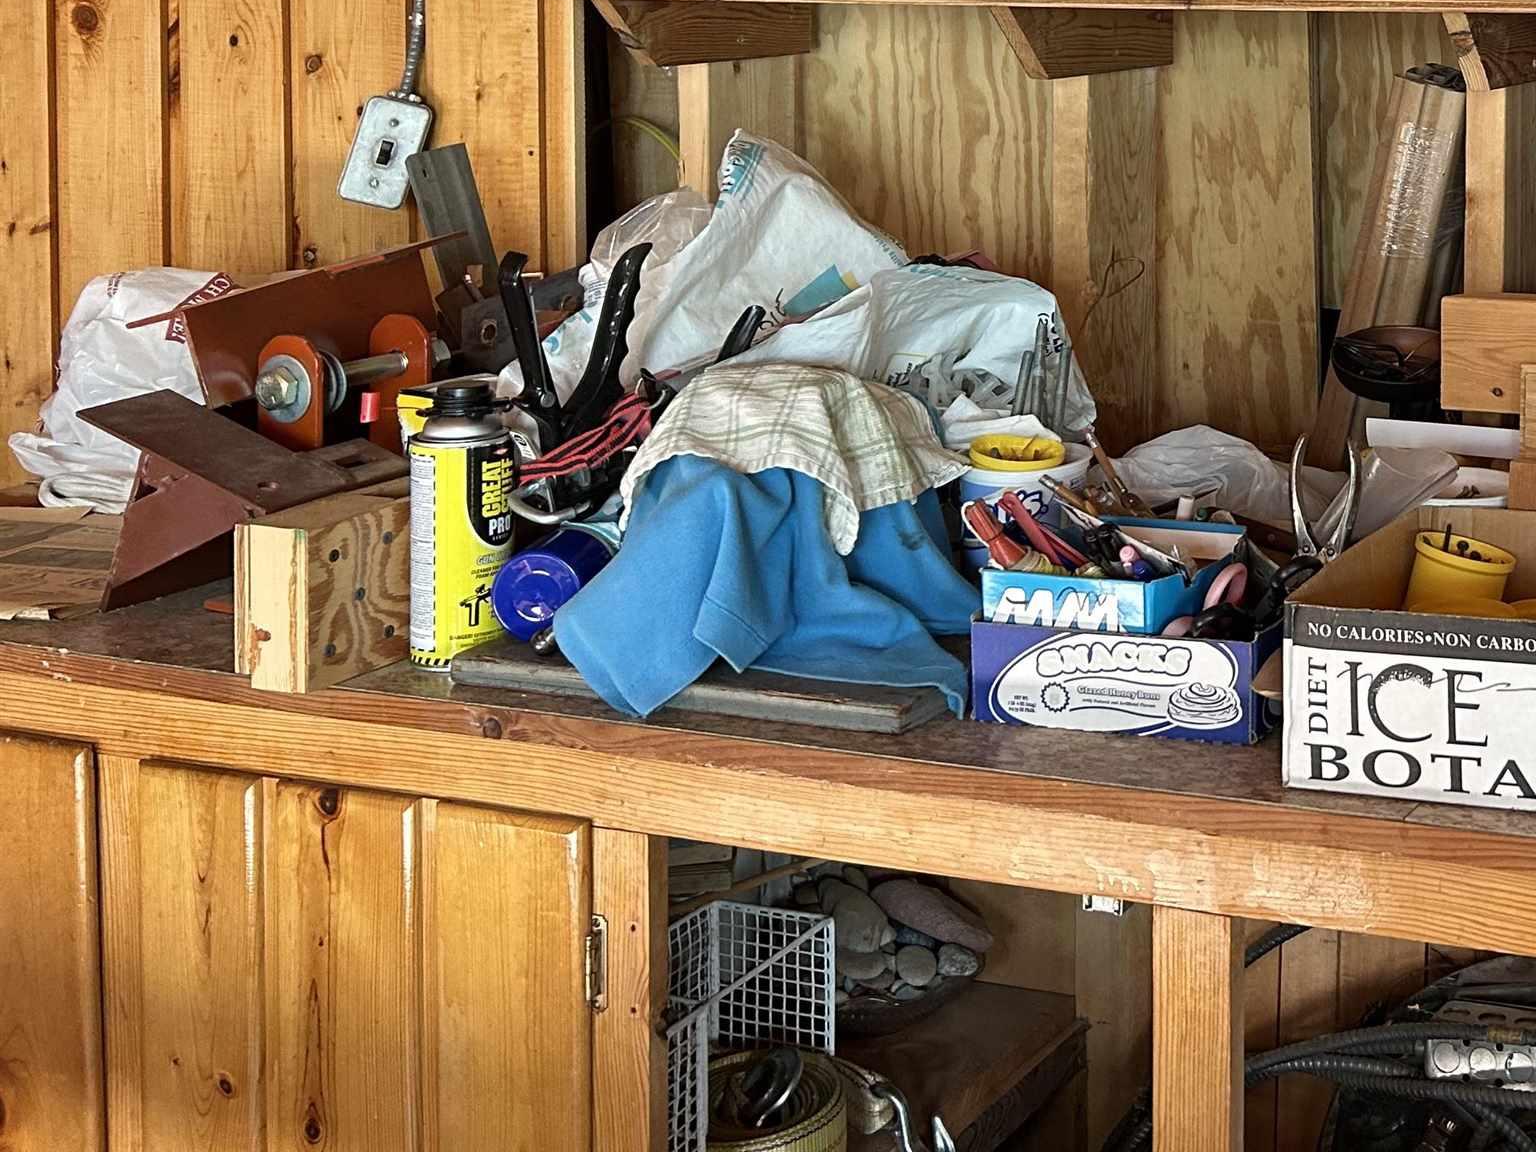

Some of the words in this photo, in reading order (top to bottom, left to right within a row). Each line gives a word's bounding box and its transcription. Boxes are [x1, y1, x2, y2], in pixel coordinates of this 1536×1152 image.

[482, 461, 502, 519] GREAT
[488, 517, 512, 536] PRO
[1307, 622, 1331, 638] NO
[1036, 642, 1192, 677] SNACKS
[1307, 657, 1329, 734] DIET
[1344, 661, 1488, 748] ICE
